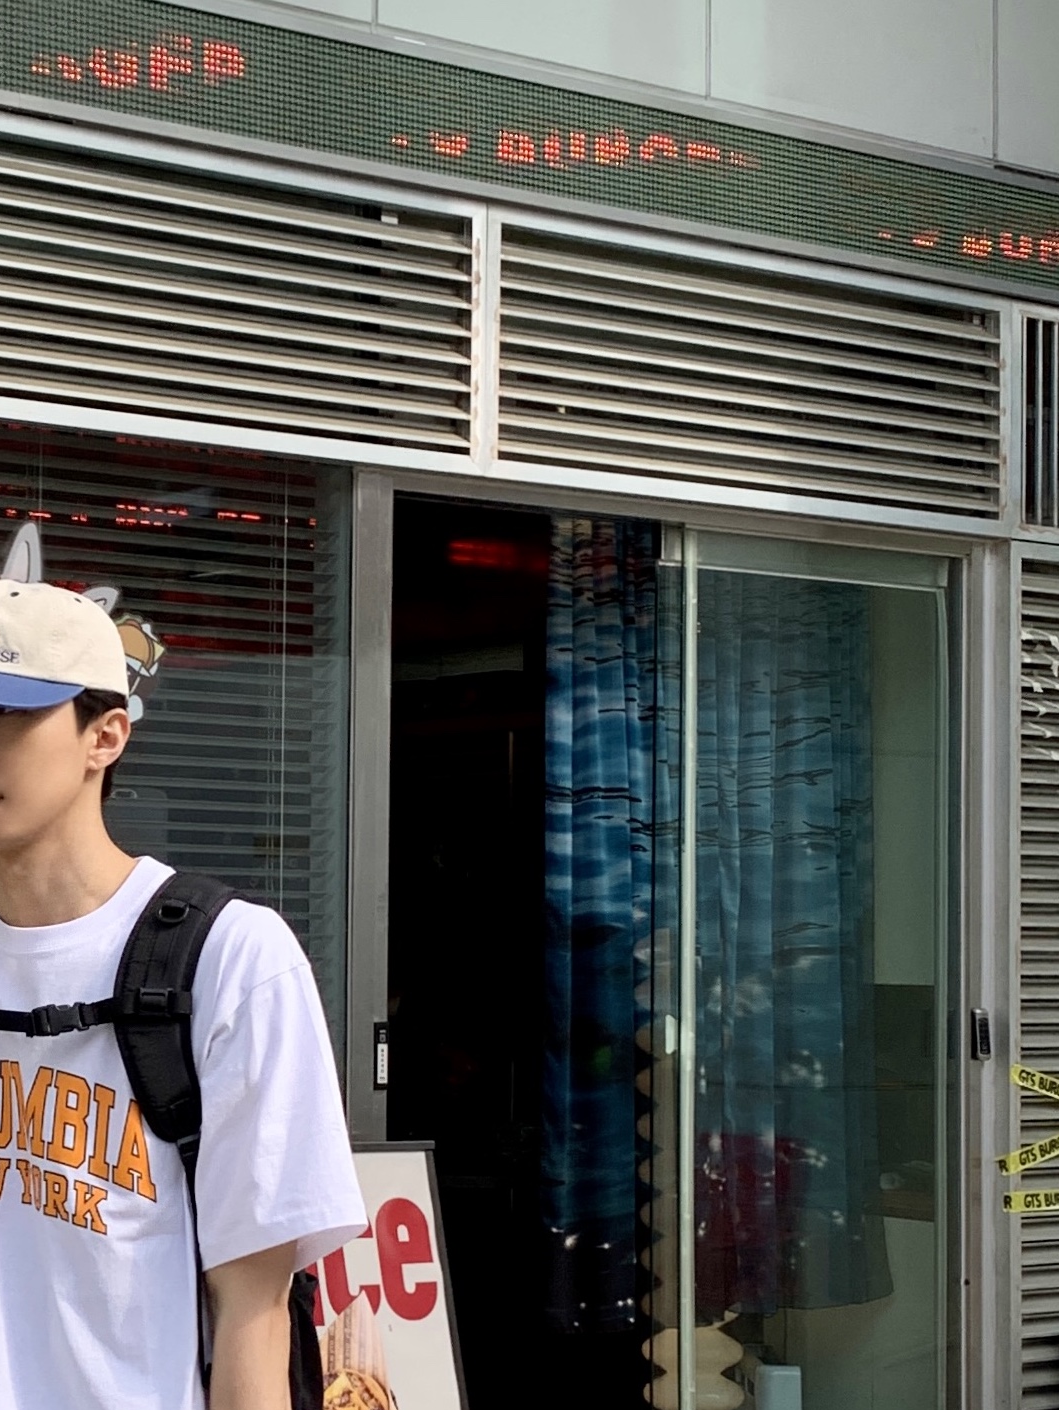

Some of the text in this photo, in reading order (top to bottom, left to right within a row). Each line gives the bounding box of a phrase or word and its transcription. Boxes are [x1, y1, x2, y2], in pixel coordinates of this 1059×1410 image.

[1018, 1069, 1037, 1086] GTS
[1019, 1147, 1037, 1166] GTS
[1024, 1194, 1041, 1208] GTS
